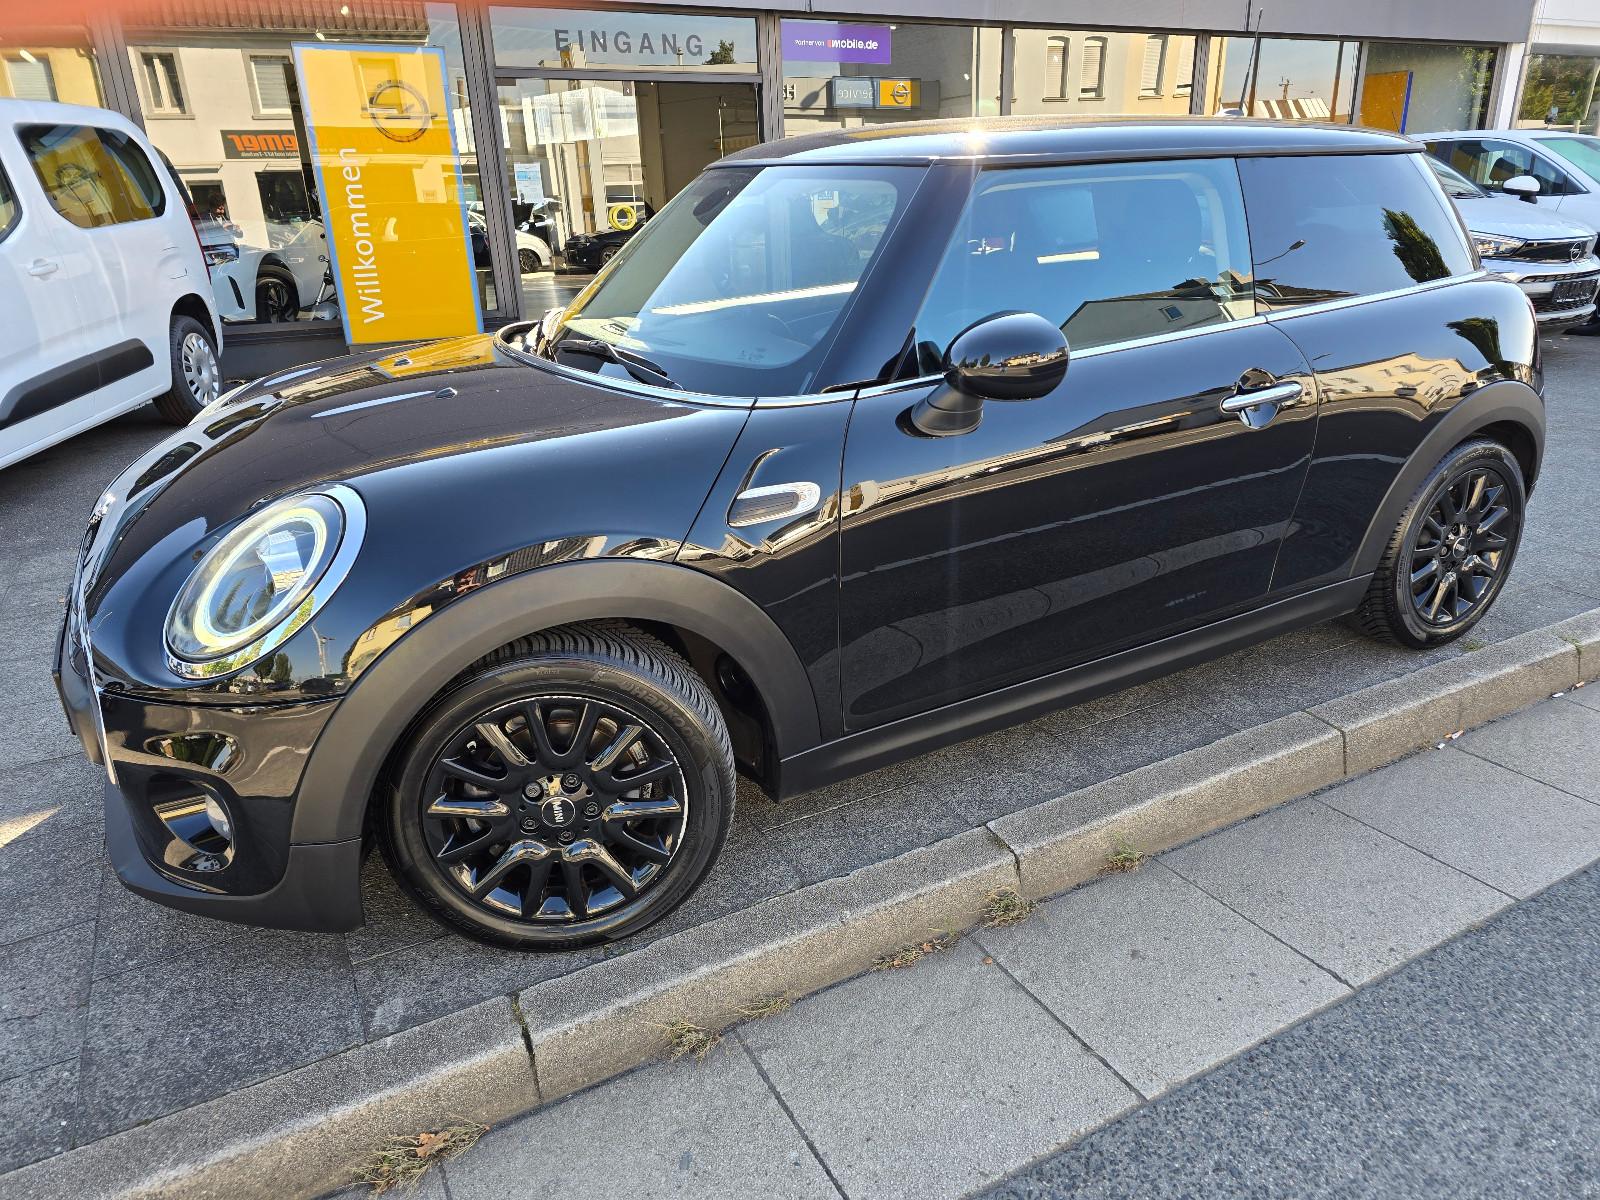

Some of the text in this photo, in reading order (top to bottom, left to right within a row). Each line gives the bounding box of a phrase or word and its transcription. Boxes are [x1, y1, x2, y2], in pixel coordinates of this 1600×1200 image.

[554, 29, 703, 57] EINGANG
[831, 38, 879, 50] mobile.de
[339, 148, 385, 324] Willkommen
[552, 801, 565, 823] MINI
